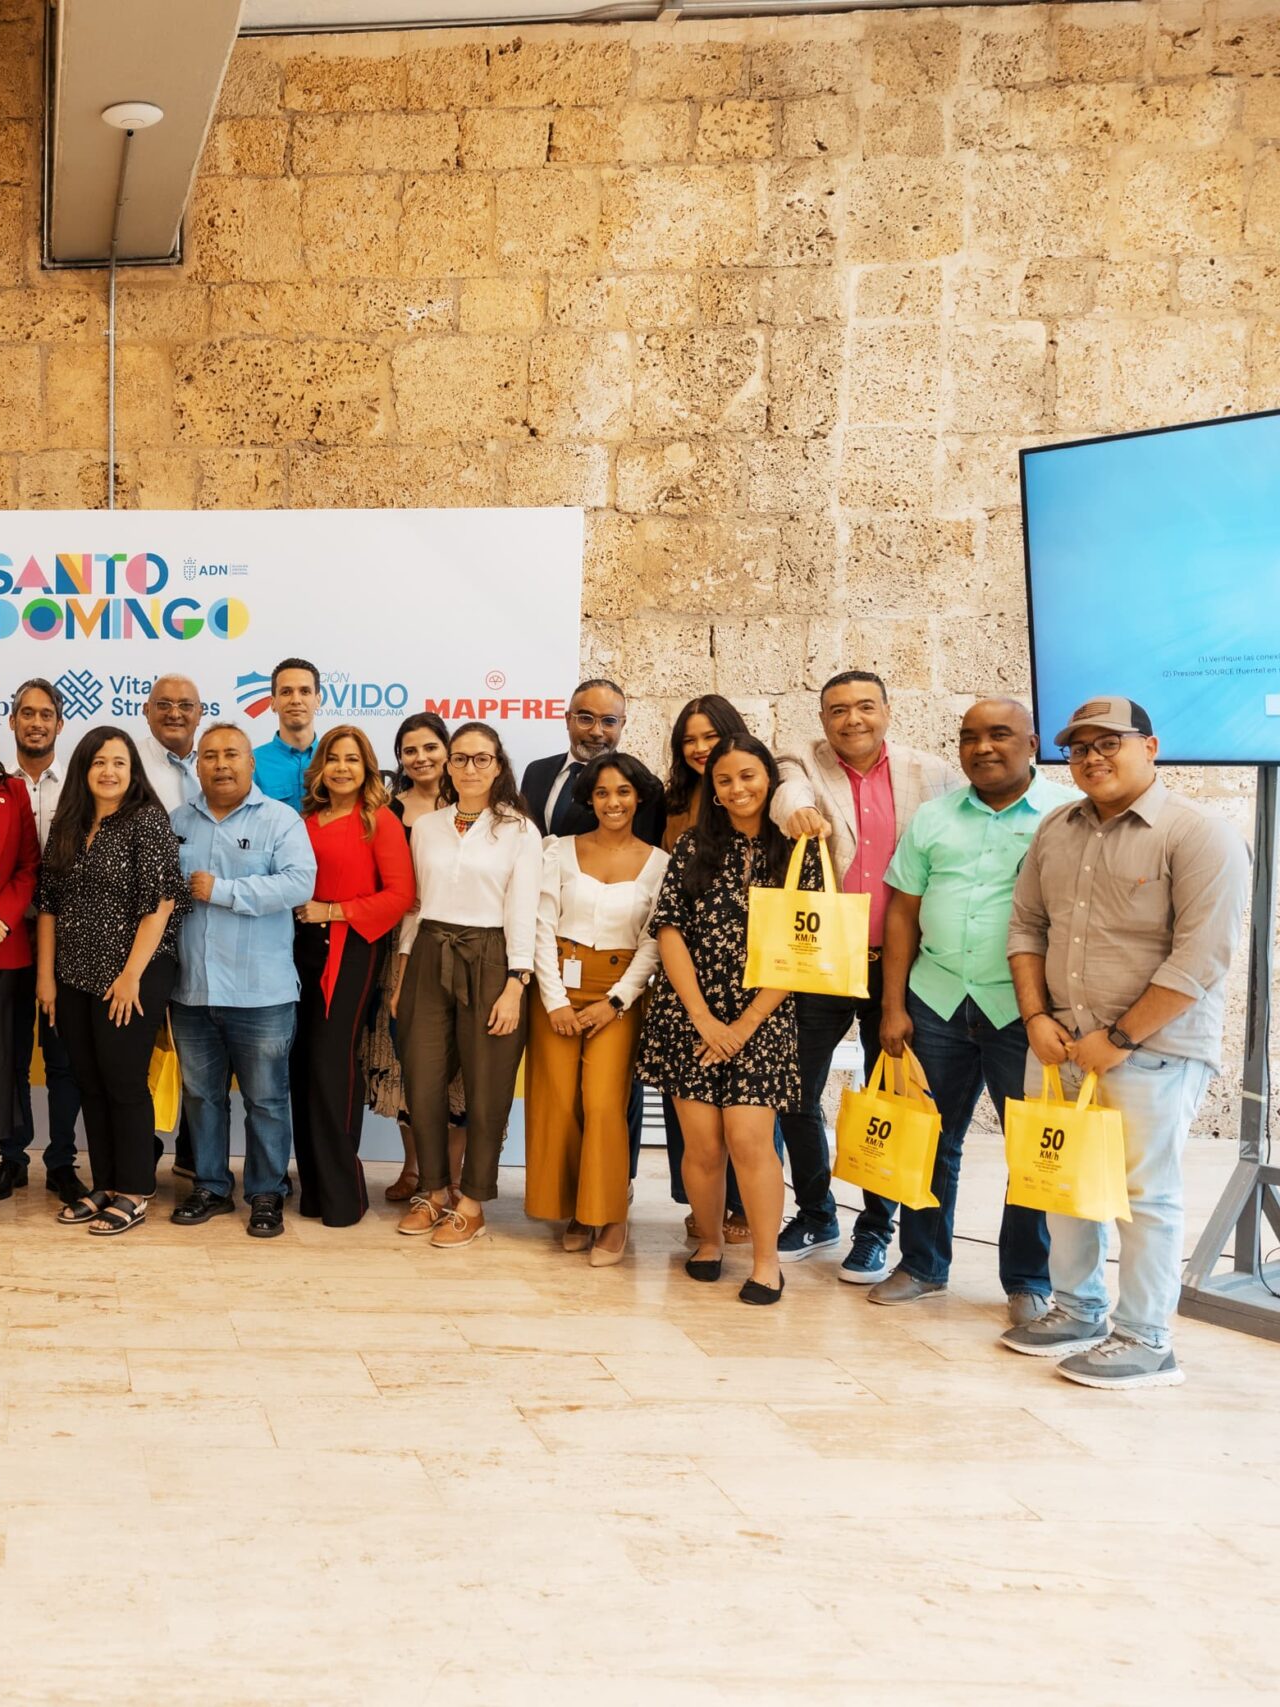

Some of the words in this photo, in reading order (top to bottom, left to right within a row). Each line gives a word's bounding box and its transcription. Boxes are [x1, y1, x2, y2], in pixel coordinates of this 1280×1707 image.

[199, 564, 228, 576] ADN
[1204, 668, 1234, 676] SOURCE
[109, 675, 158, 695] Vita
[347, 708, 405, 717] DOMINICANA
[424, 698, 566, 720] MAPFRE
[794, 910, 820, 933] 50
[795, 933, 818, 943] KM/h
[866, 1116, 892, 1140] 50
[864, 1136, 885, 1149] KM/h
[1039, 1126, 1065, 1151] 50
[1039, 1149, 1060, 1161] KM/h
